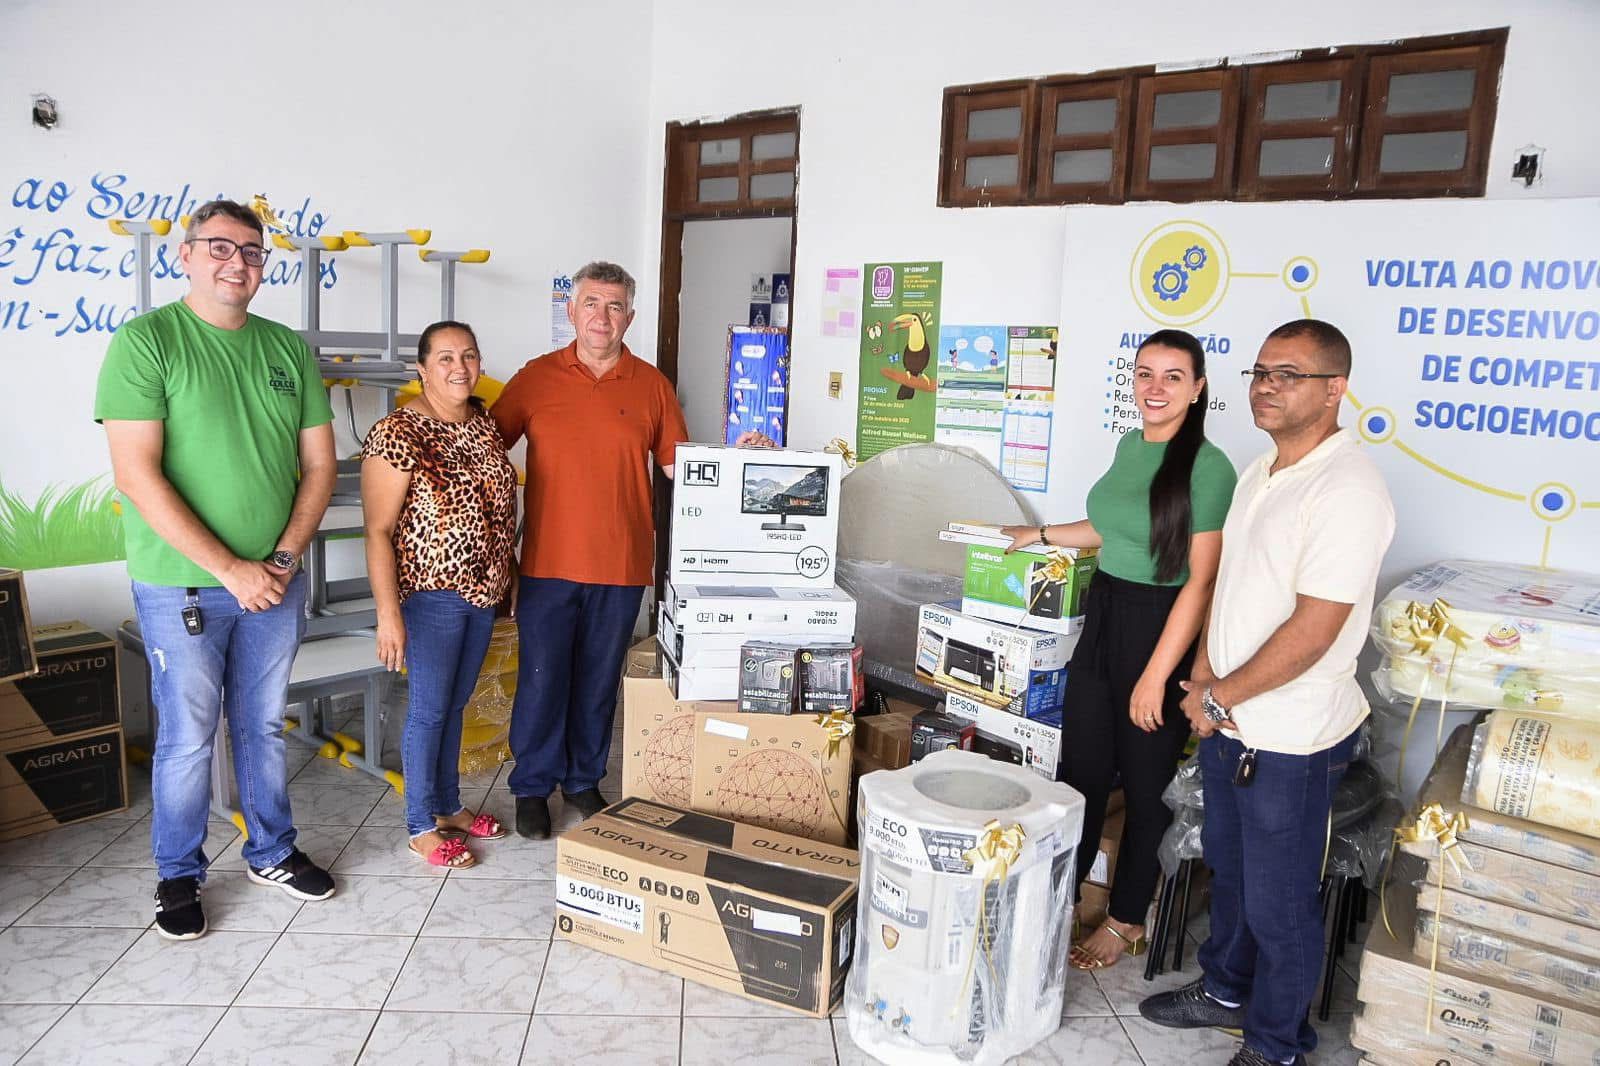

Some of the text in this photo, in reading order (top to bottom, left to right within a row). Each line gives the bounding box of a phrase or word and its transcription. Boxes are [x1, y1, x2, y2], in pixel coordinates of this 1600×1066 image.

[13, 177, 73, 212] ao
[553, 275, 571, 289] PÓS
[1366, 260, 1600, 290] VOLTA AO NOV
[1398, 307, 1436, 334] DE
[1422, 354, 1600, 392] DE COMPET
[687, 463, 717, 482] HQ
[681, 507, 702, 517] LED
[923, 611, 951, 626] EPSON
[1036, 637, 1057, 649] EPSON
[743, 689, 789, 699] estabilizador
[805, 692, 849, 700] estabilizador
[950, 696, 979, 714] EPSON
[23, 743, 111, 771] AGRATTO
[883, 818, 907, 836] ECO
[582, 826, 688, 861] AGRATTO
[603, 866, 628, 882] ECO
[569, 882, 604, 902] 9.000
